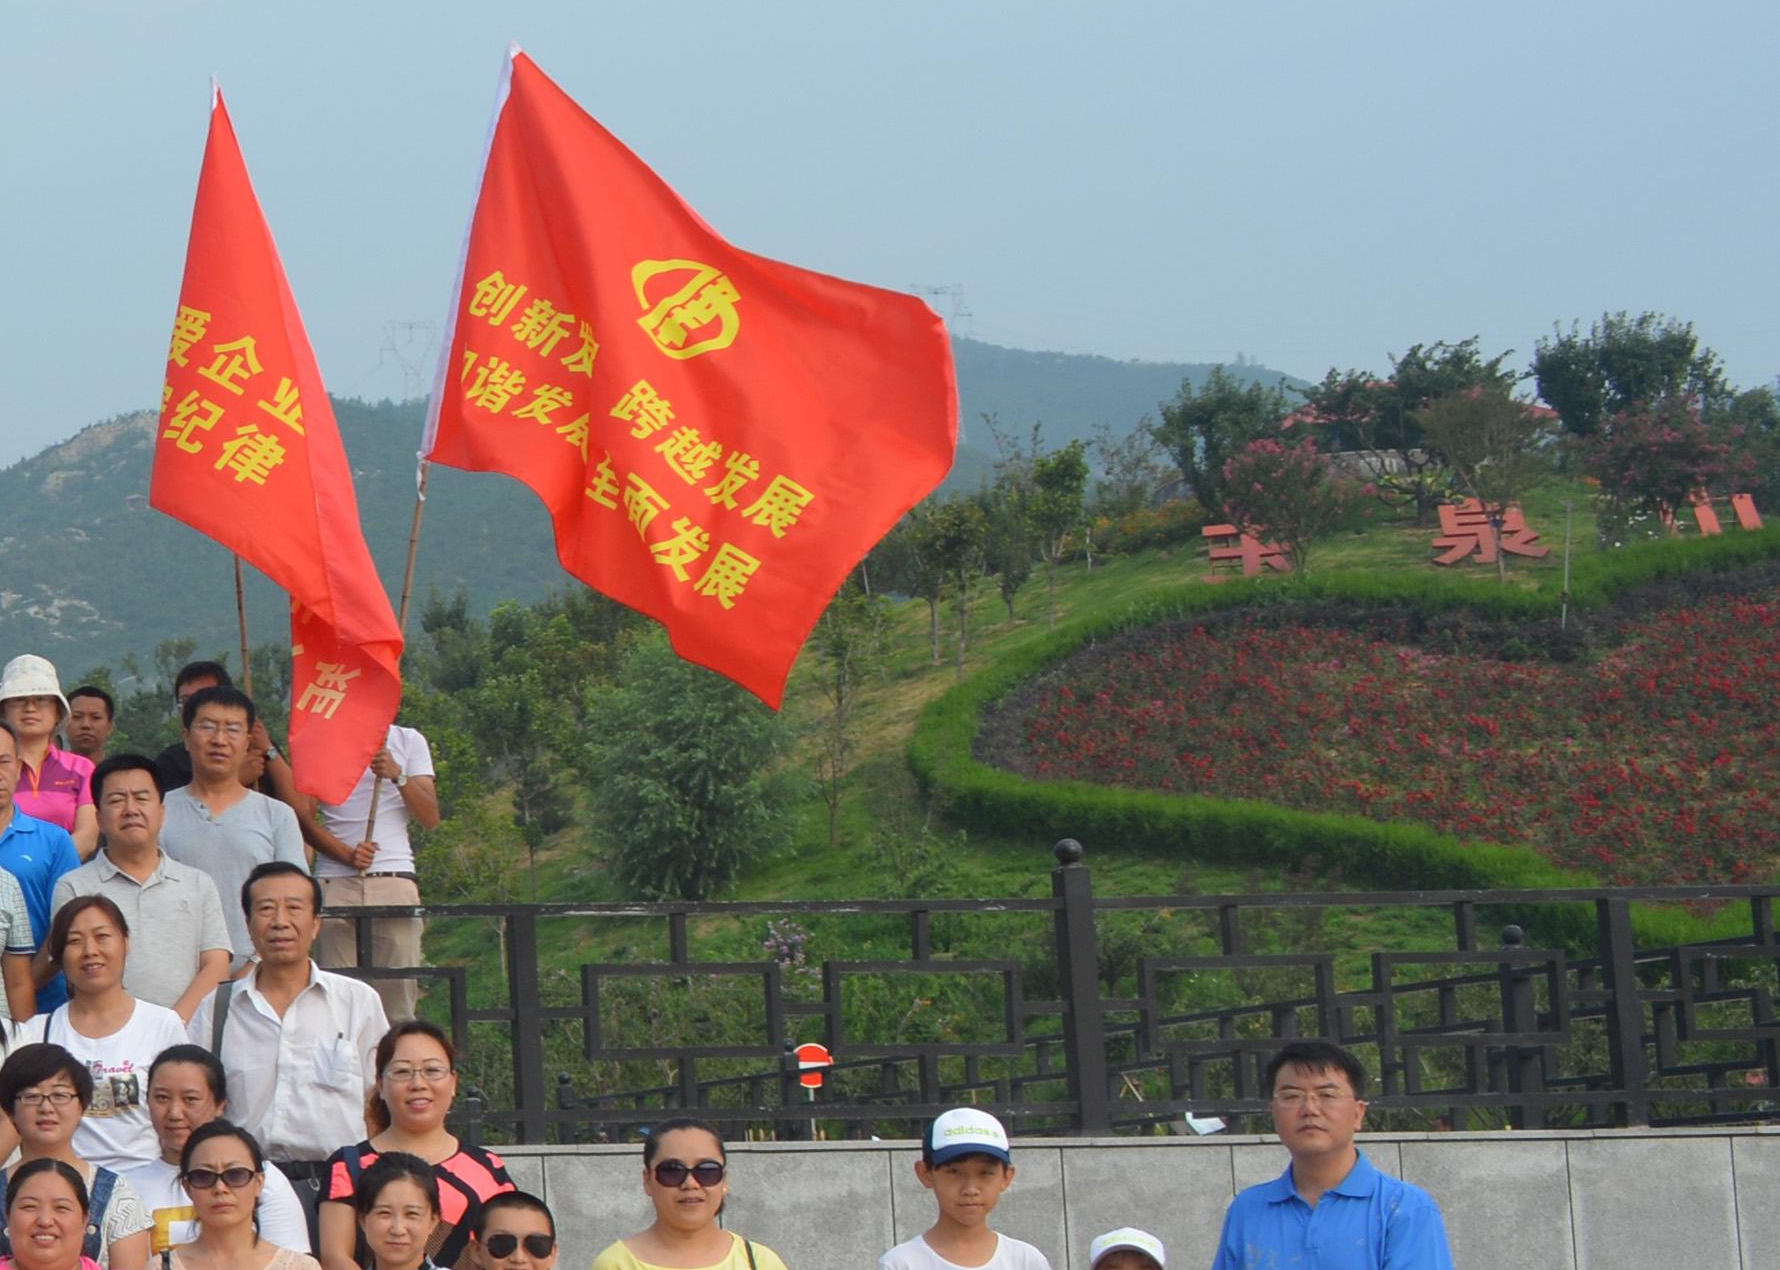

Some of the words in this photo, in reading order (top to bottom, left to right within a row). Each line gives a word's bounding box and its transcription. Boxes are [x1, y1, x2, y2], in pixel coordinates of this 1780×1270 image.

[160, 386, 285, 487] 纪律
[609, 379, 814, 540] 跨越发展
[94, 1062, 134, 1074] Travel
